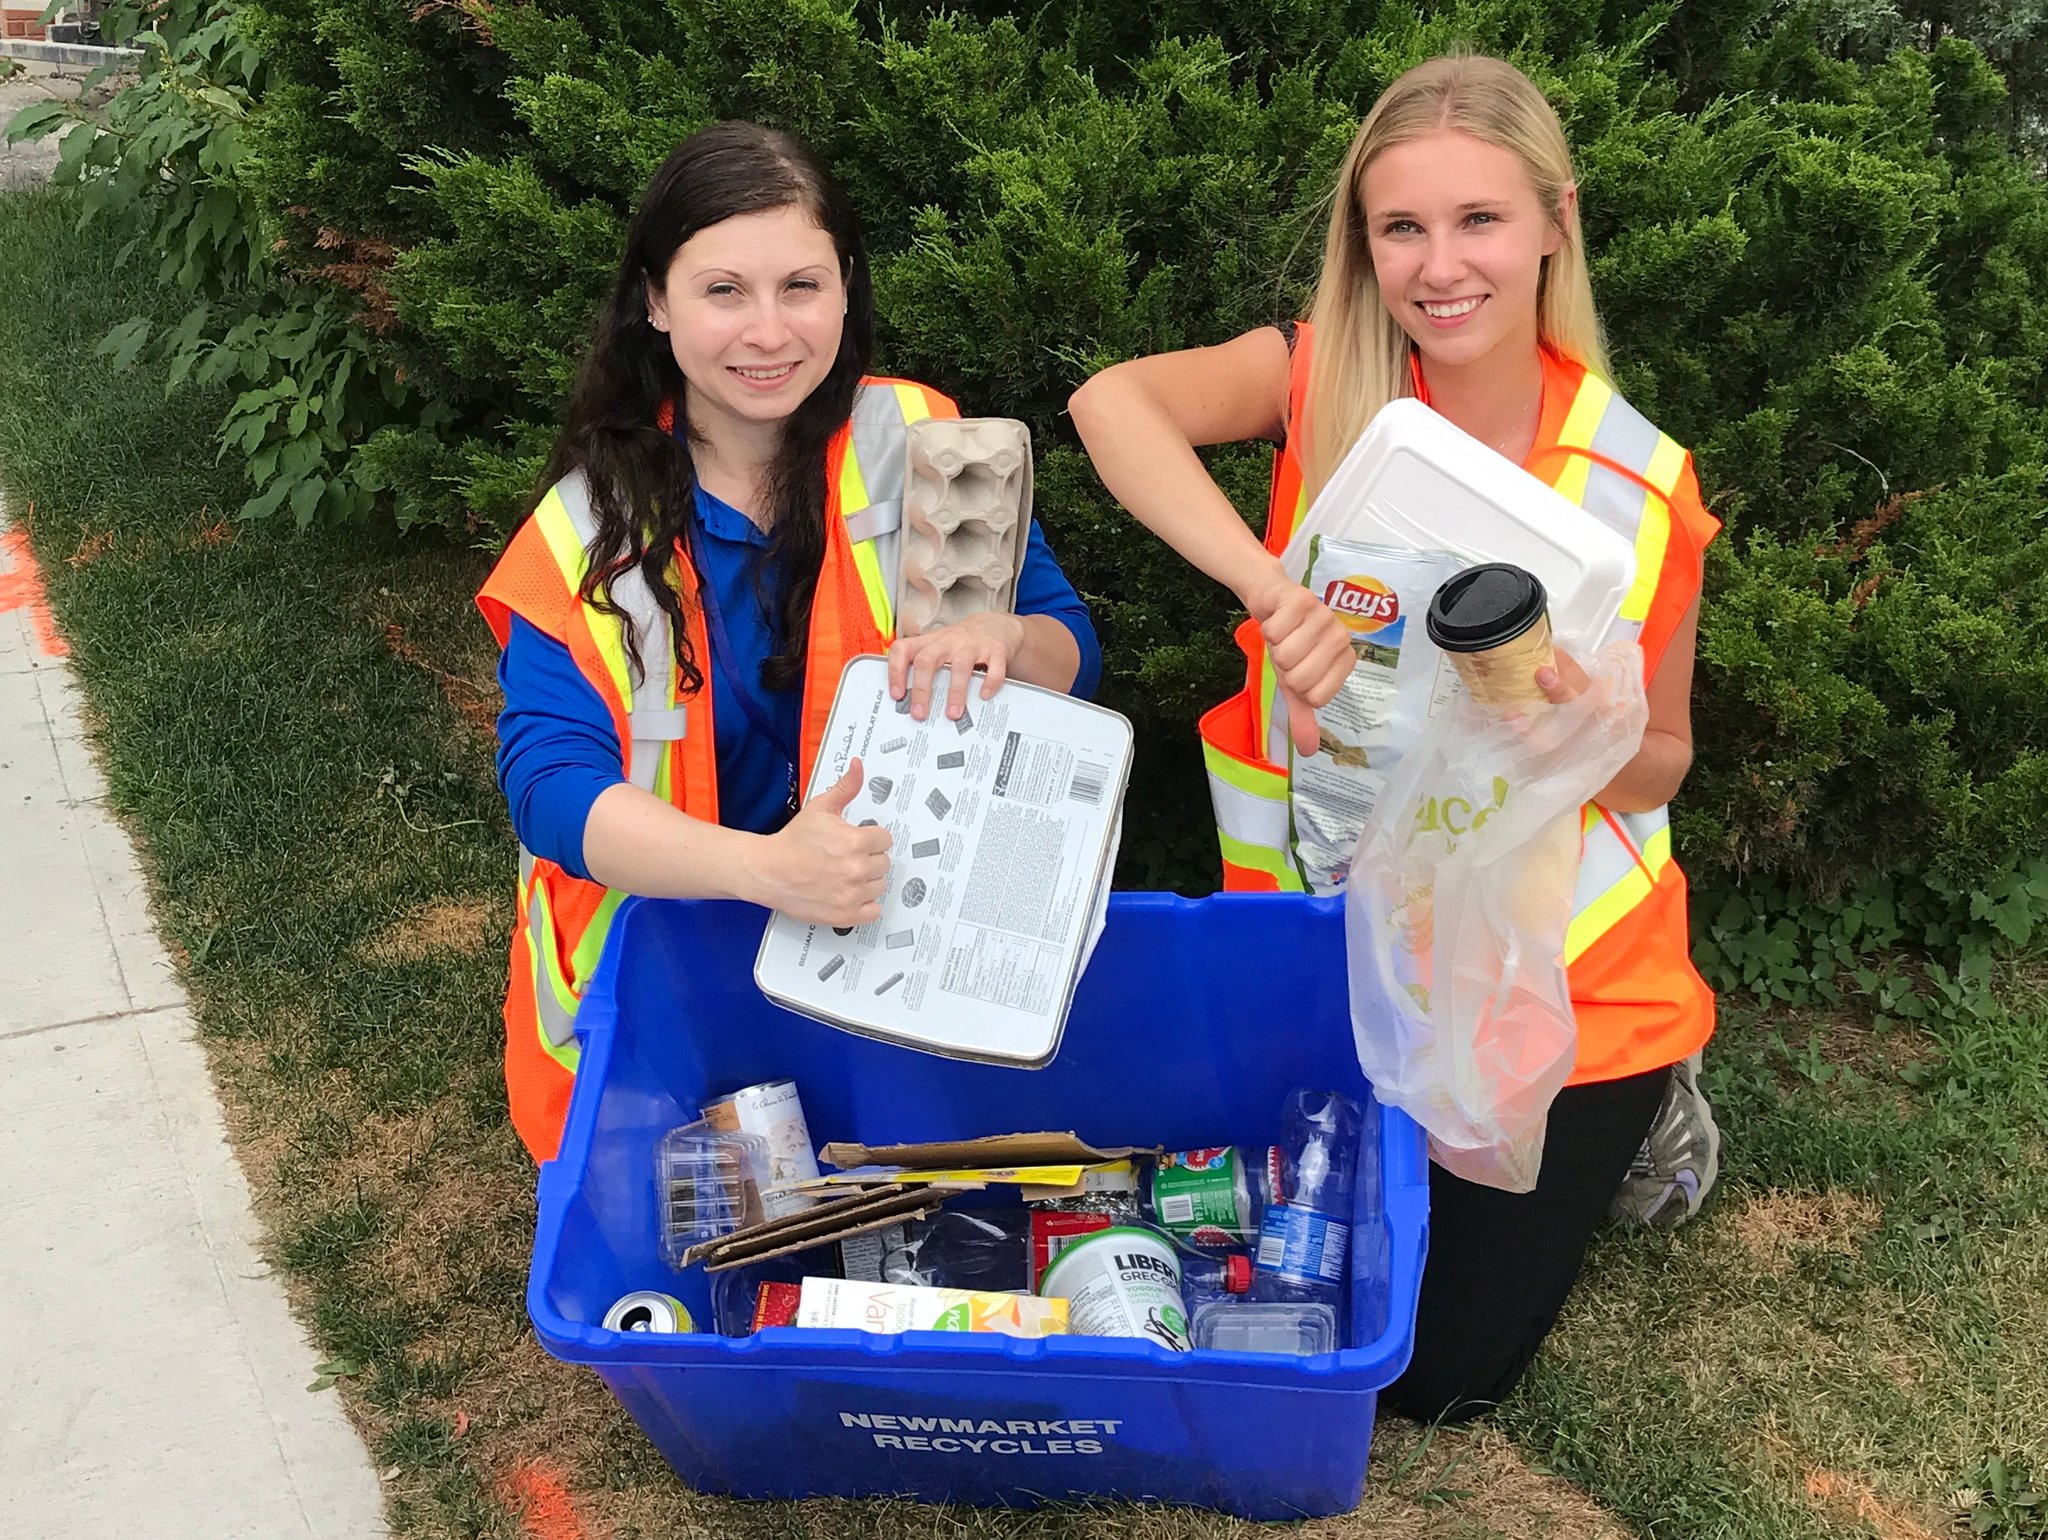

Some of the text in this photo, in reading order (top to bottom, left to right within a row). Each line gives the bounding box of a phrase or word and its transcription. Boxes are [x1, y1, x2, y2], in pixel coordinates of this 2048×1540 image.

[860, 688, 885, 757] CHOCOLAT BELGE
[798, 931, 814, 967] BELGIAN
[839, 1412, 1123, 1435] NEWMARKET
[872, 1434, 1104, 1454] RECYCLES
